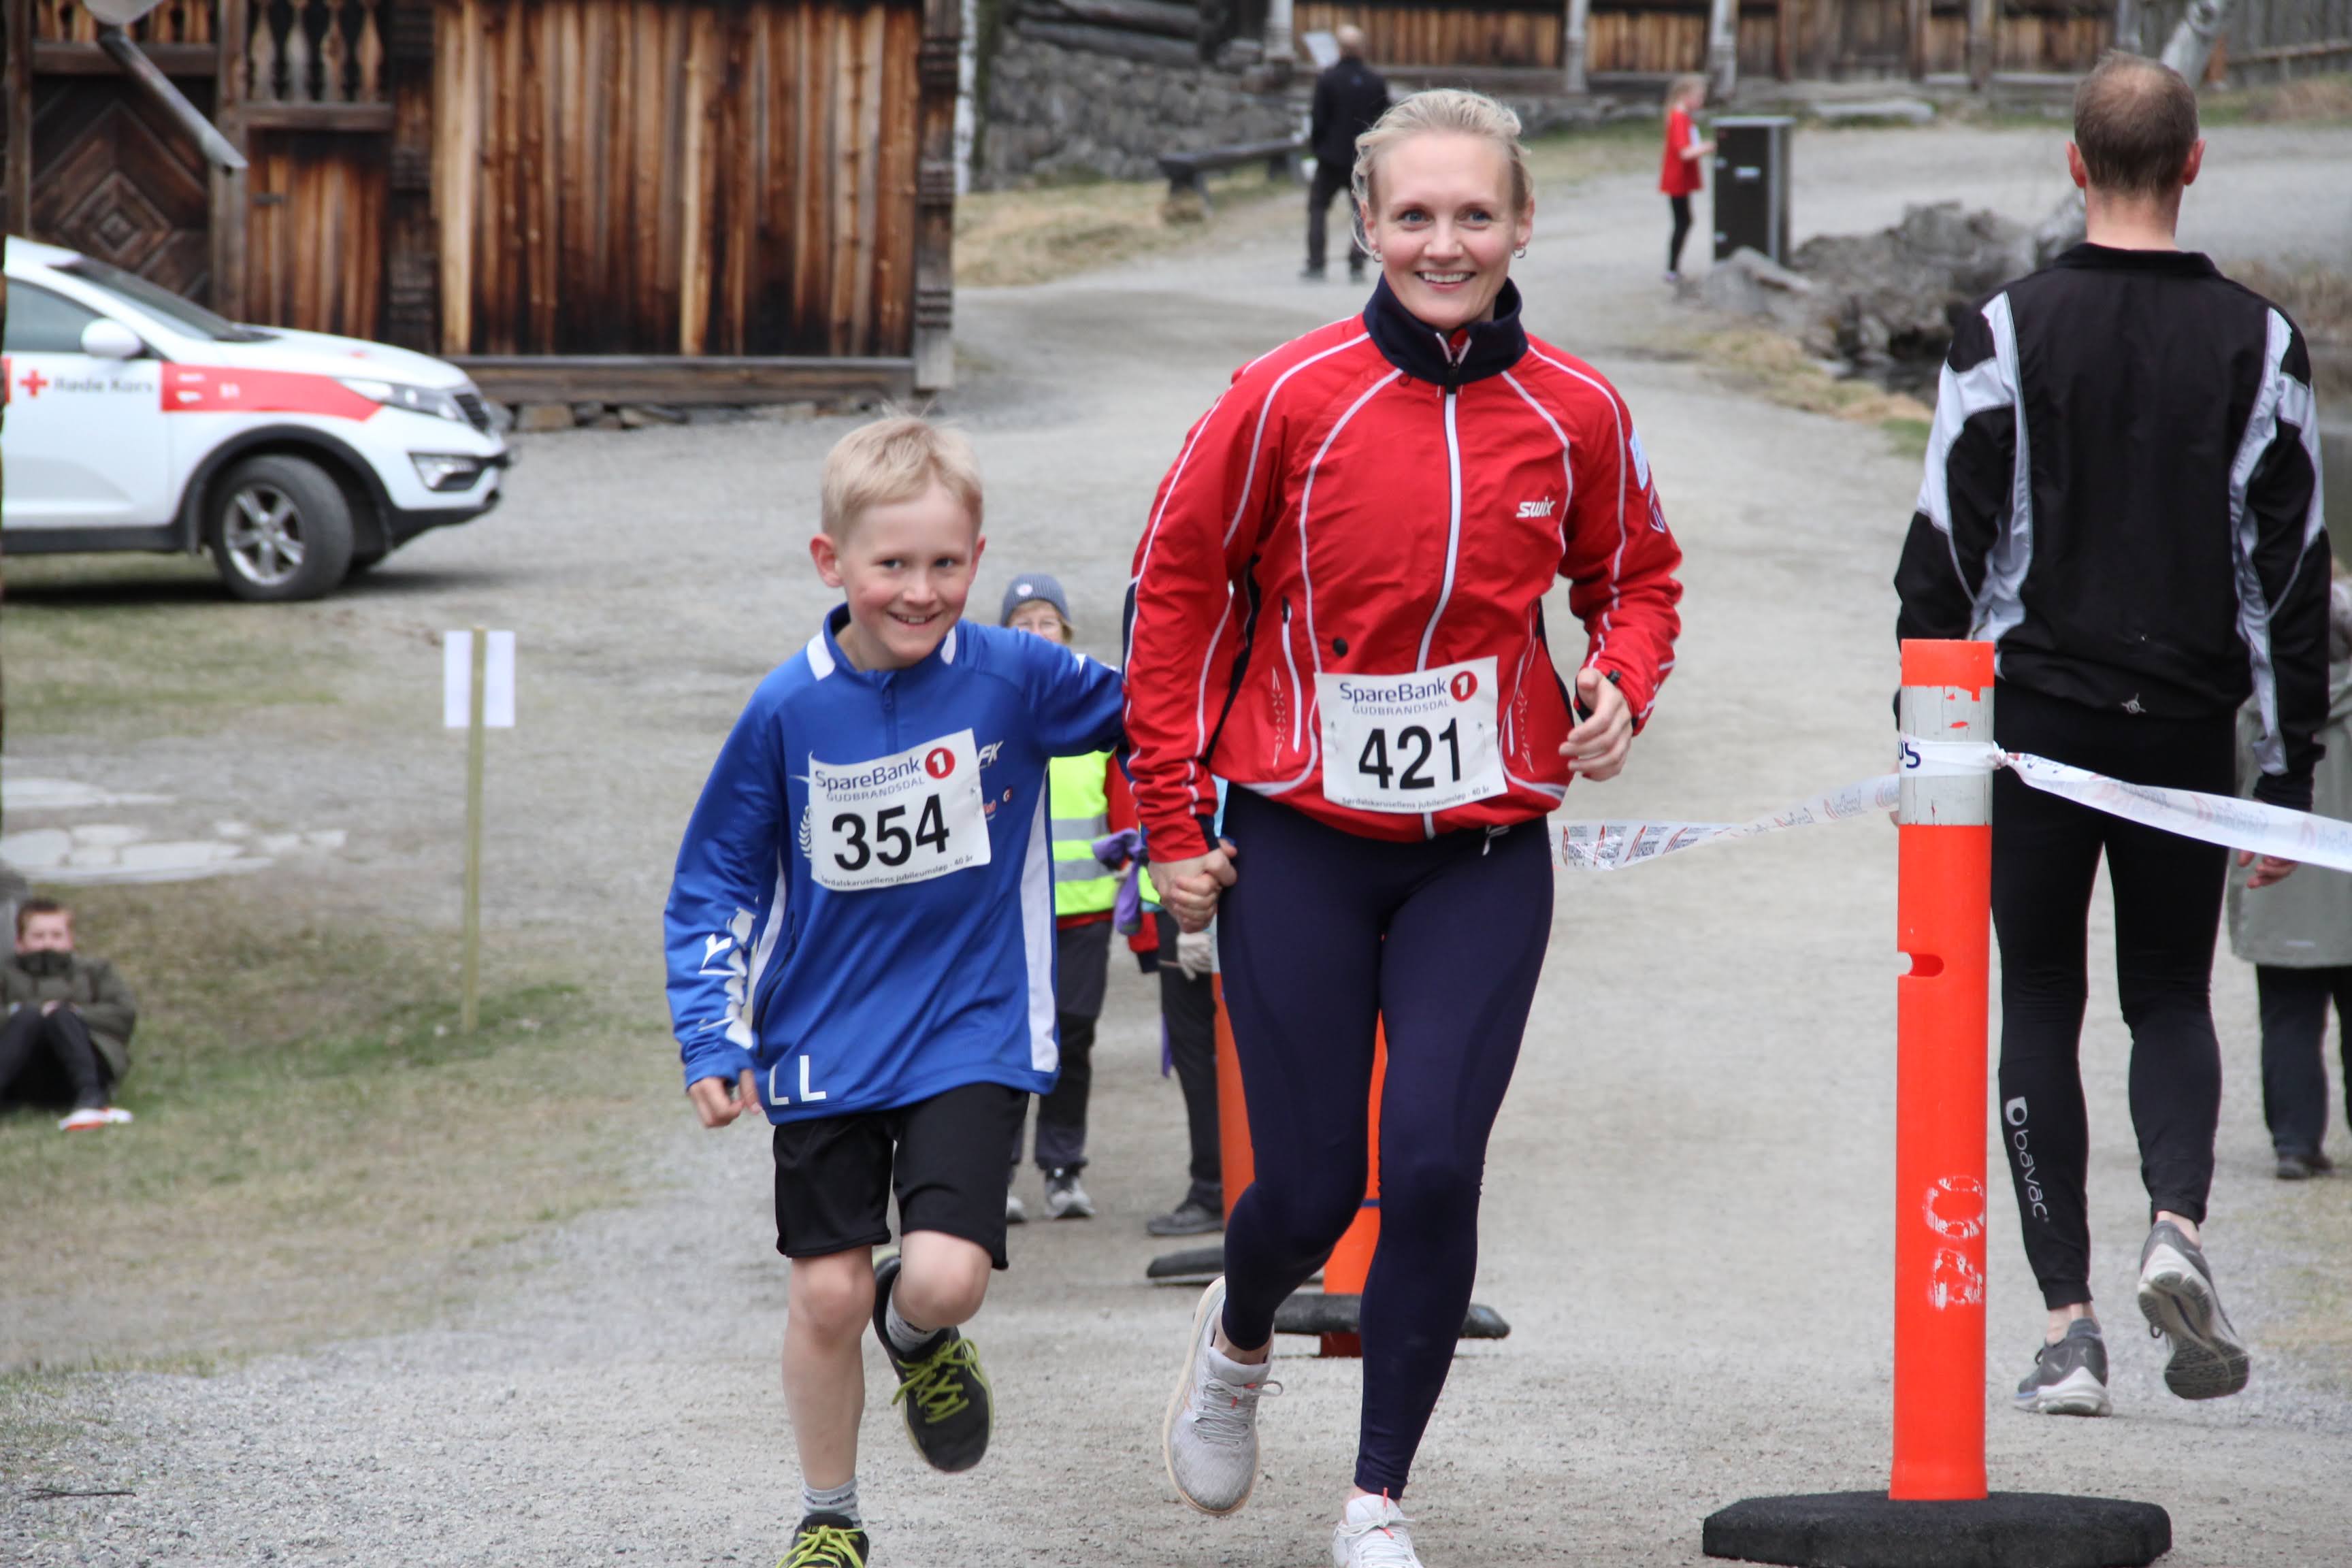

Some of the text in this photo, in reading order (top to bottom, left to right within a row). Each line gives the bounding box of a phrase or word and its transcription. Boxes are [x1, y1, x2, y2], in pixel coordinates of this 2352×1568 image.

[1339, 678, 1447, 704] SpareBank
[1352, 699, 1450, 715] GUDBRANDSDAL
[1359, 717, 1460, 789] 421
[815, 756, 921, 792] SpareBank
[826, 777, 926, 802] GUDBRANDSDAL
[832, 794, 950, 872] 354
[896, 864, 949, 883] jubileumsløp
[954, 858, 964, 866] 40
[2014, 1129, 2048, 1218] bavac
